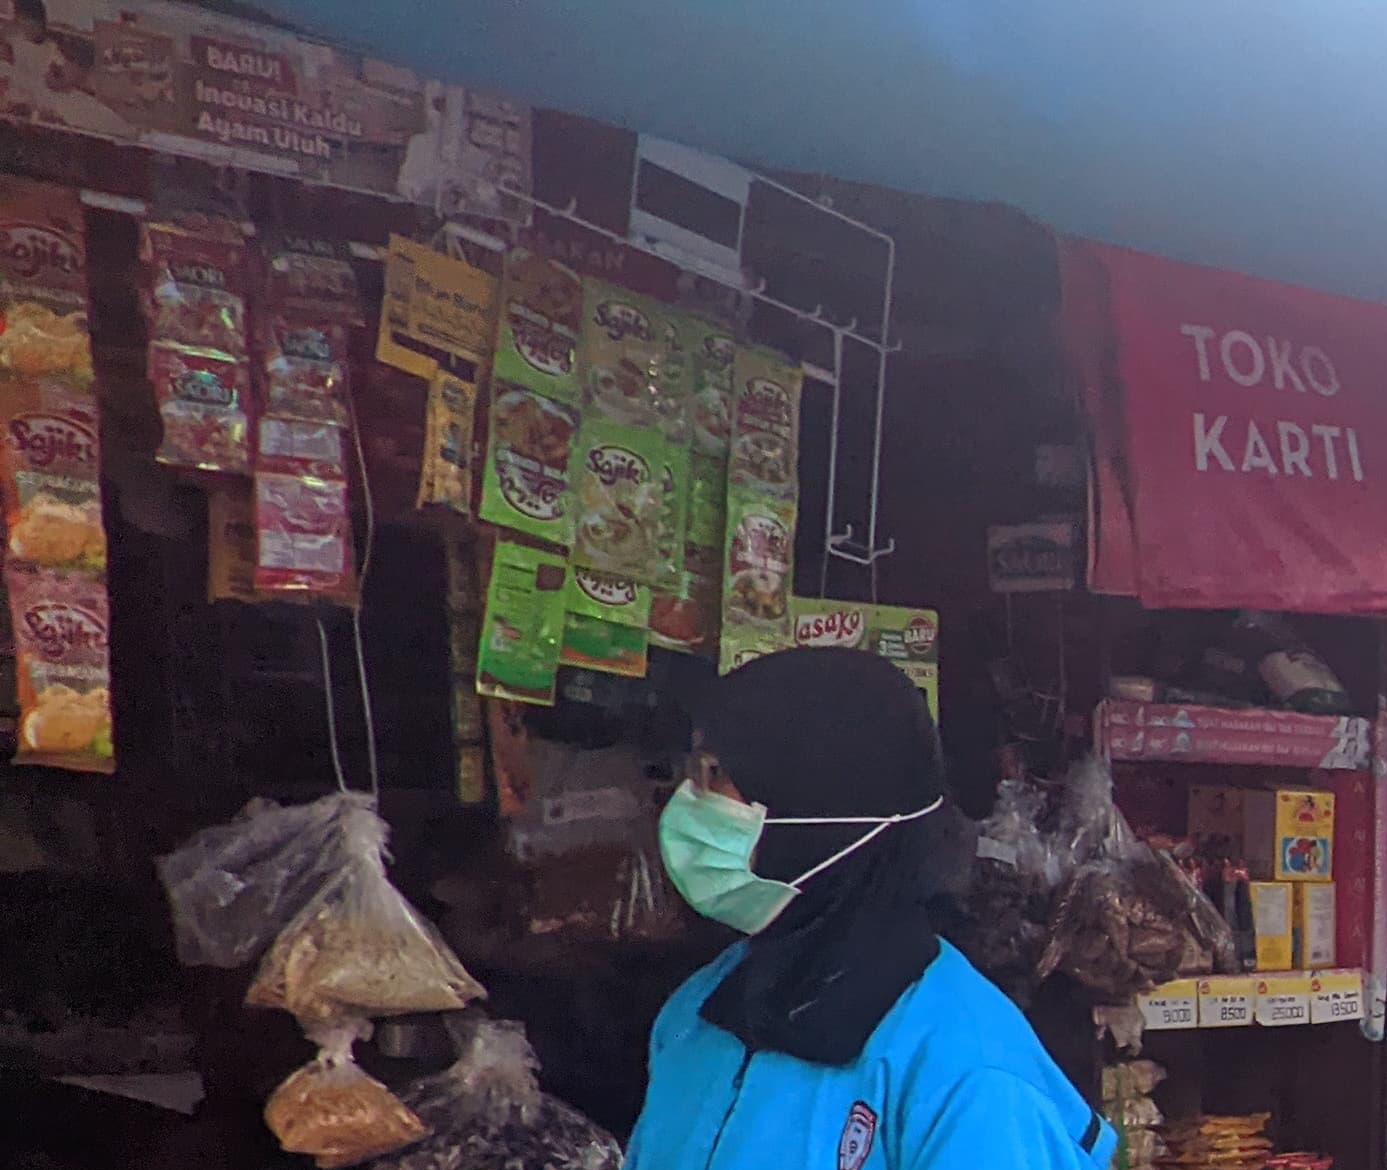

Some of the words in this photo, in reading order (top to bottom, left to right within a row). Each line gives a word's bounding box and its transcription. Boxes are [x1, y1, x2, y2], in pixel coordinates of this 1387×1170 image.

[206, 45, 281, 81] BARU!
[197, 110, 269, 143] Ayam
[273, 125, 331, 158] Utuh
[294, 103, 362, 137] Kaldu
[1182, 322, 1341, 397] TOKO
[1190, 411, 1366, 482] KARTI
[795, 610, 860, 641] asako
